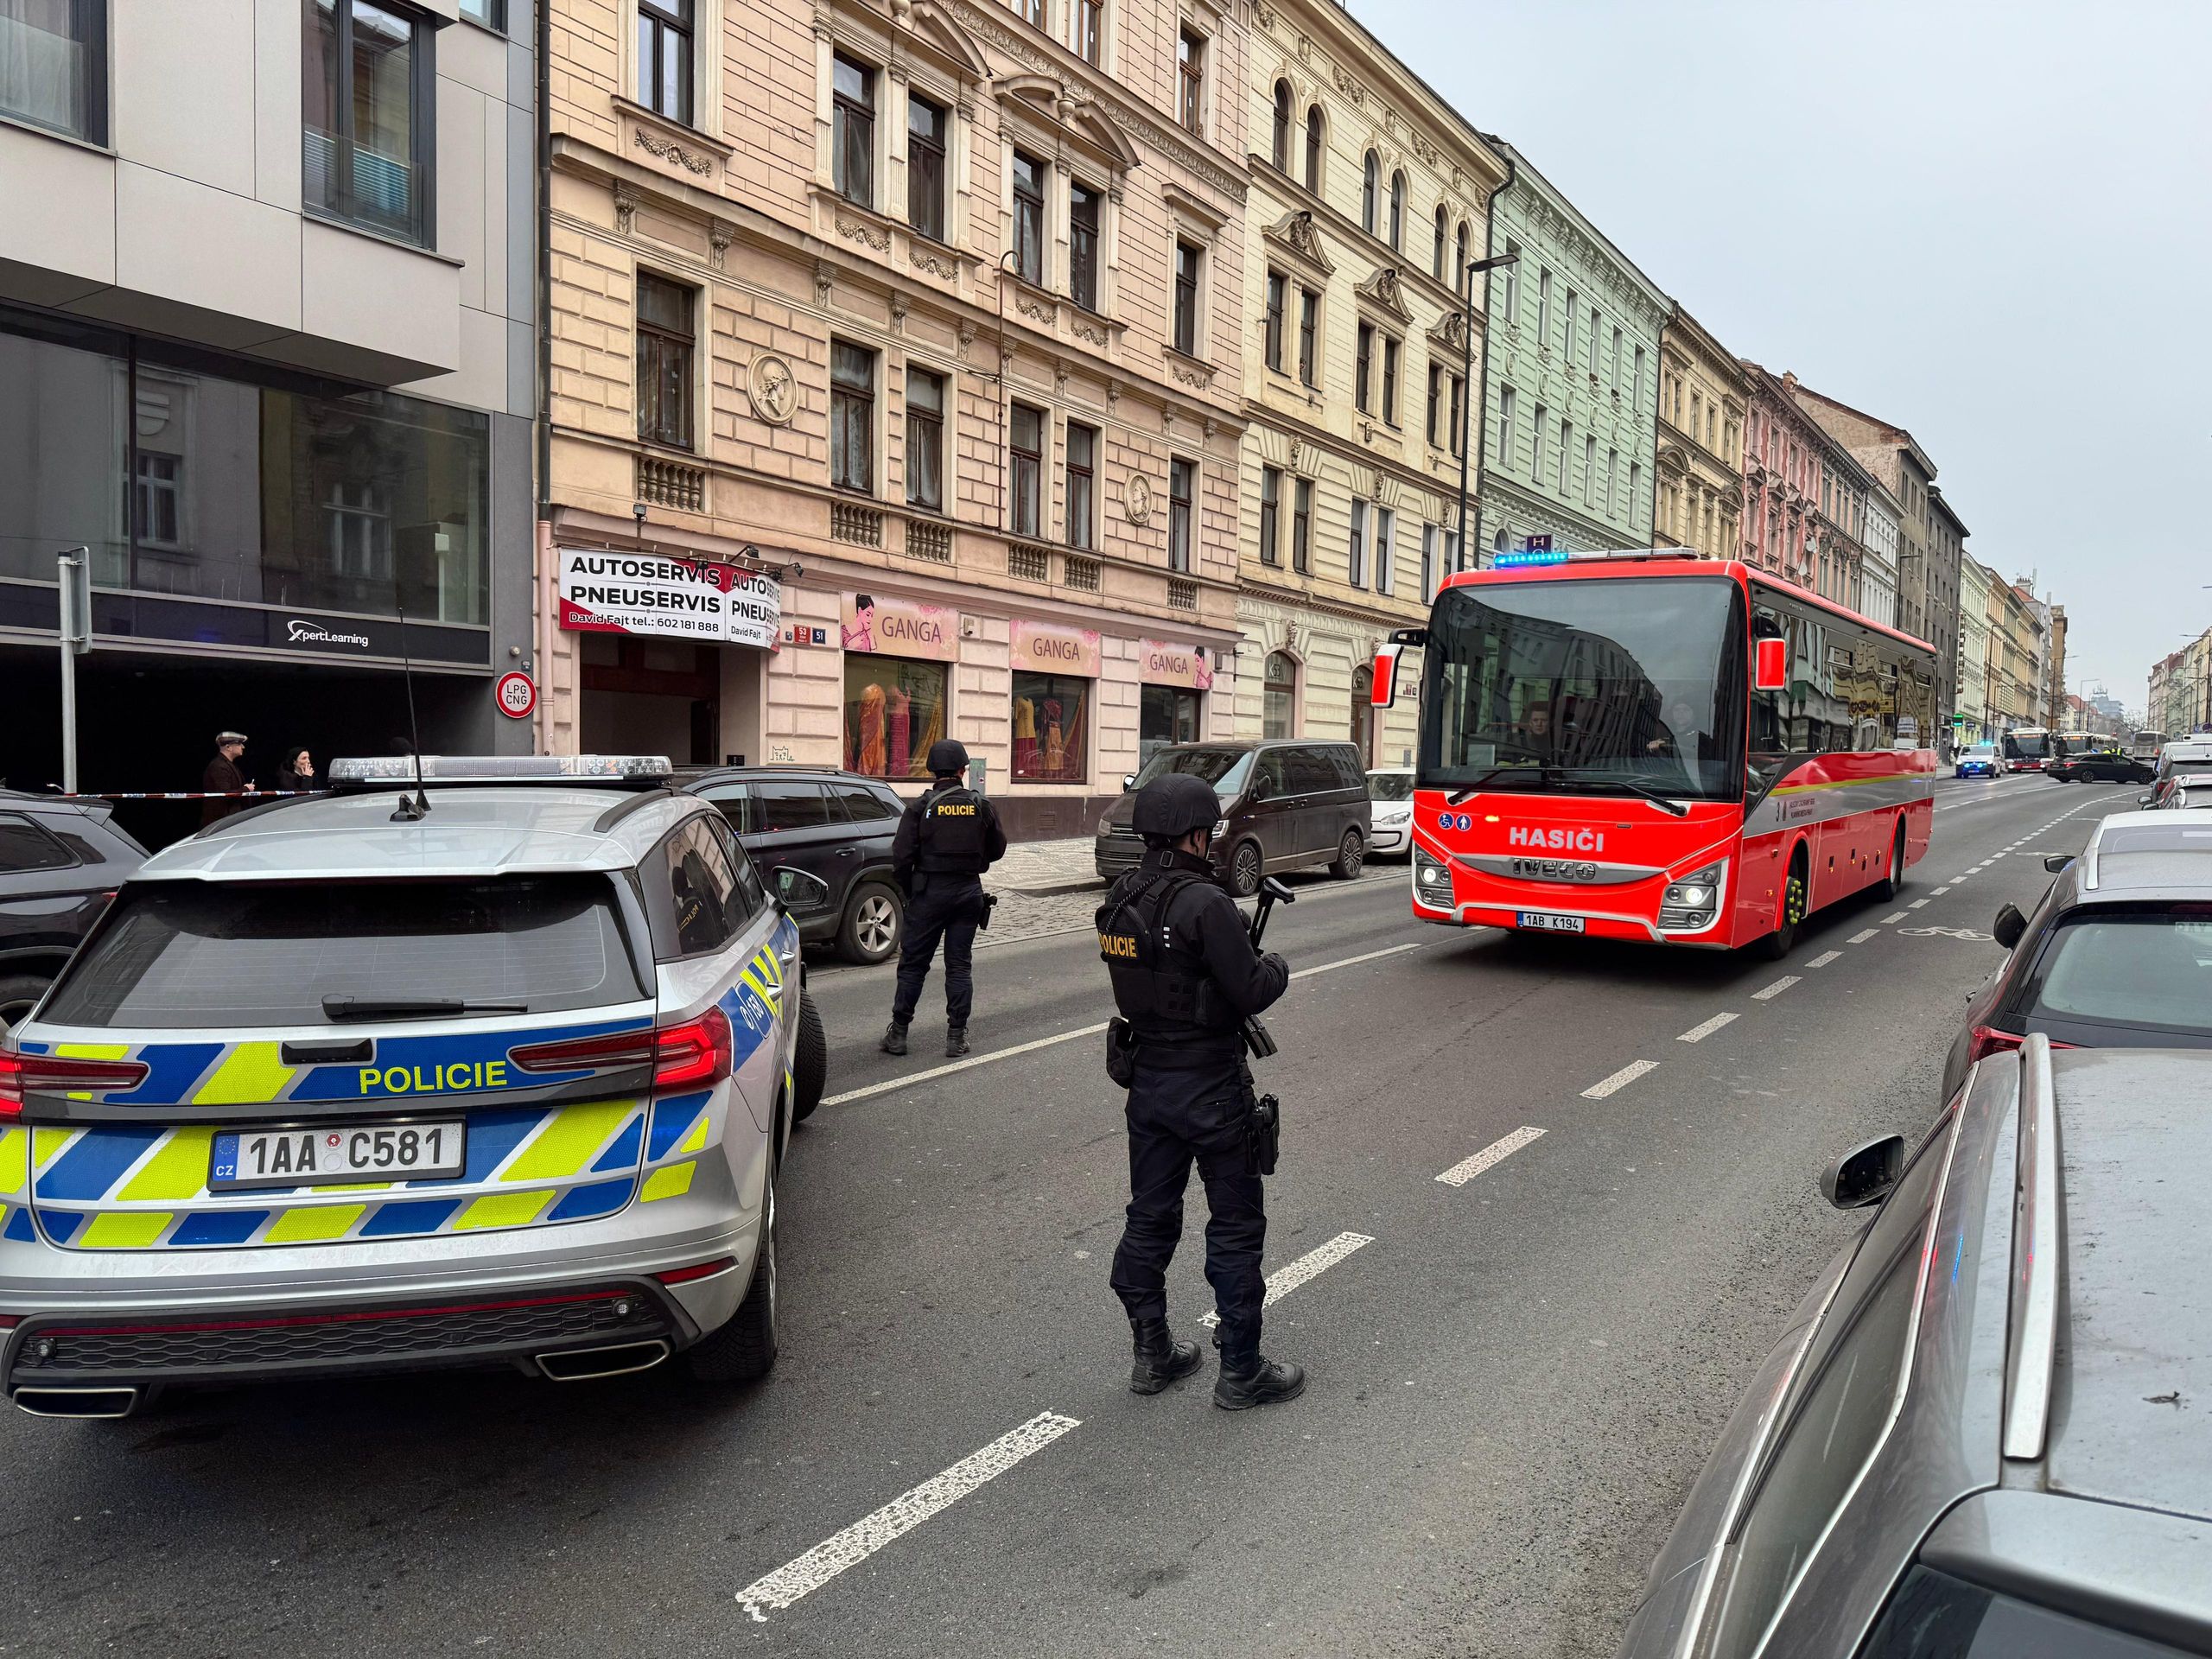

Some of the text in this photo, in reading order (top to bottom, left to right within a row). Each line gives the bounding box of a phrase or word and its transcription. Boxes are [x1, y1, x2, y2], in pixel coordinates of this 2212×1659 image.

[570, 556, 721, 585] AUTOSERVIS
[570, 586, 721, 613] PNEUSERVIS
[288, 620, 369, 647] XpertLearning
[570, 613, 604, 622] David
[607, 614, 629, 626] Fajt
[657, 618, 678, 628] 602
[680, 620, 695, 630] 181
[697, 621, 719, 632] 888
[731, 626, 748, 637] David
[748, 629, 761, 639] Fajt
[798, 626, 807, 636] 53
[881, 616, 943, 644] GANGA
[816, 632, 823, 640] 51
[1033, 638, 1080, 662] GANGA
[1149, 653, 1188, 675] GANGA
[506, 684, 527, 694] LPG
[506, 695, 527, 704] CNG
[938, 804, 976, 816] POLICIE
[1510, 826, 1605, 852] HASIČI
[1512, 858, 1596, 880] IVECO
[1526, 915, 1579, 930] 1AB K194
[359, 1060, 508, 1094] POLICIE
[215, 1128, 442, 1177] CZ 1AA C581
